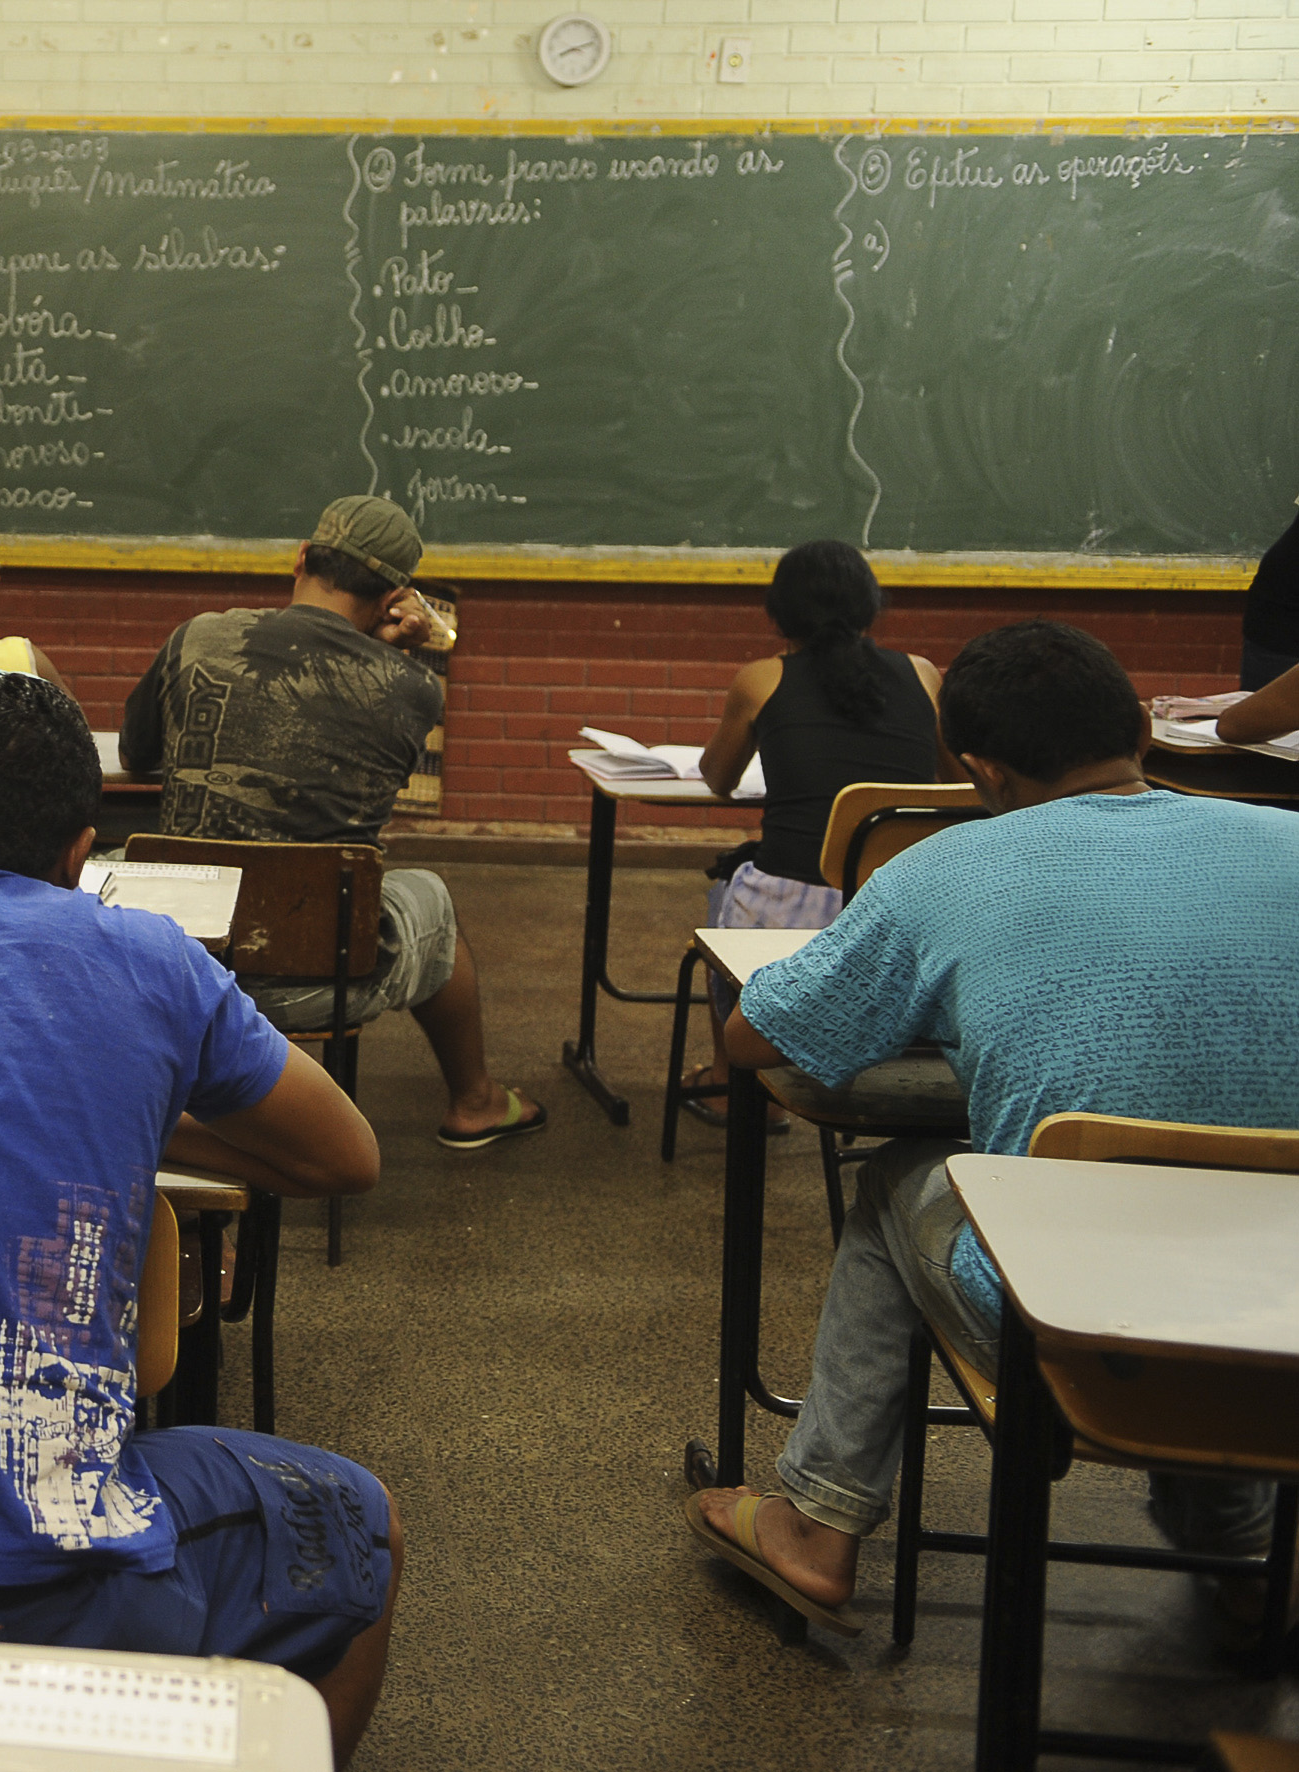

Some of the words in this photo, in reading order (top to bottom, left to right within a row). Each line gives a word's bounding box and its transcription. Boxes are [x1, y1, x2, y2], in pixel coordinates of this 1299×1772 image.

[404, 141, 493, 187] Forme
[500, 148, 598, 201] frases
[607, 141, 720, 181] usando
[736, 148, 784, 176] as
[905, 145, 1004, 209] Efetue
[1012, 161, 1051, 186] as
[401, 190, 542, 249] palavras:
[77, 245, 121, 272] as
